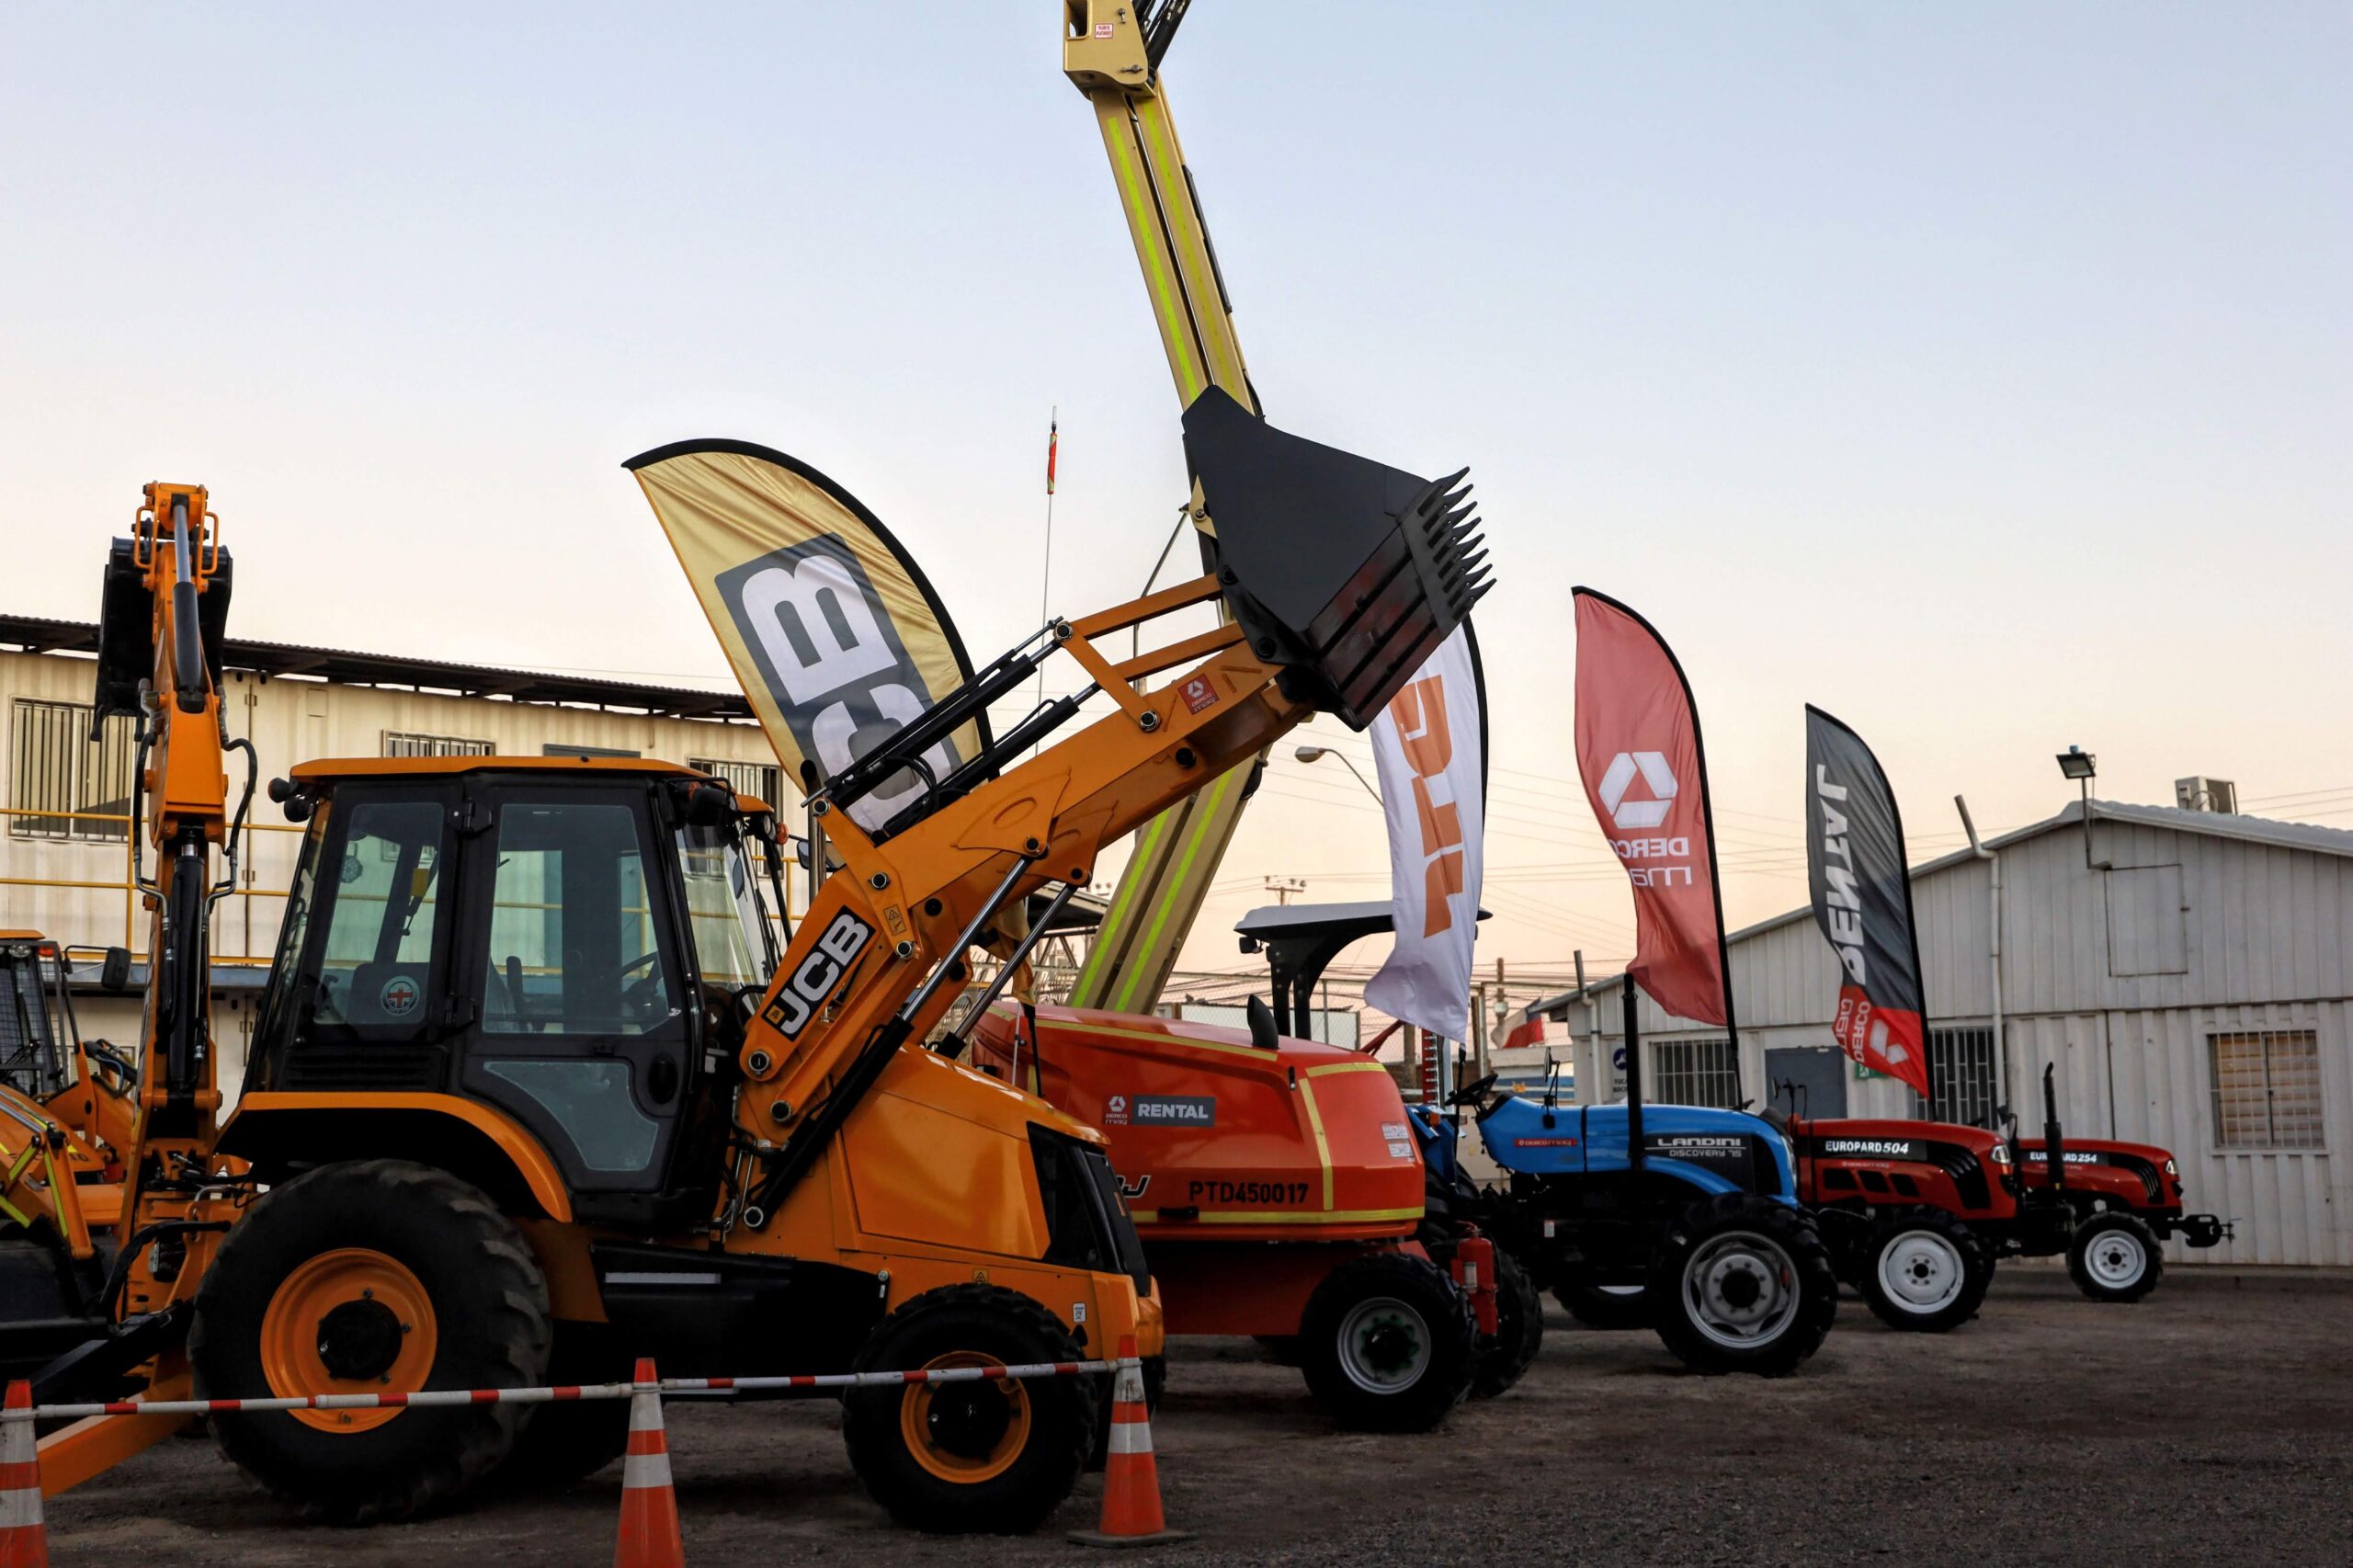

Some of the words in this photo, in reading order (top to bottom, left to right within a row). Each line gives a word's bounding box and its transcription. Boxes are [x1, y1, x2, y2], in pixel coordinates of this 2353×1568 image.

[779, 914, 869, 1035] JCB
[1138, 1103, 1209, 1119] RENTAL
[1657, 1138, 1741, 1146] LANDINI
[1669, 1149, 1725, 1157] DISCOVERY
[1728, 1149, 1742, 1157] 75
[1188, 1181, 1309, 1204] PTD450017
